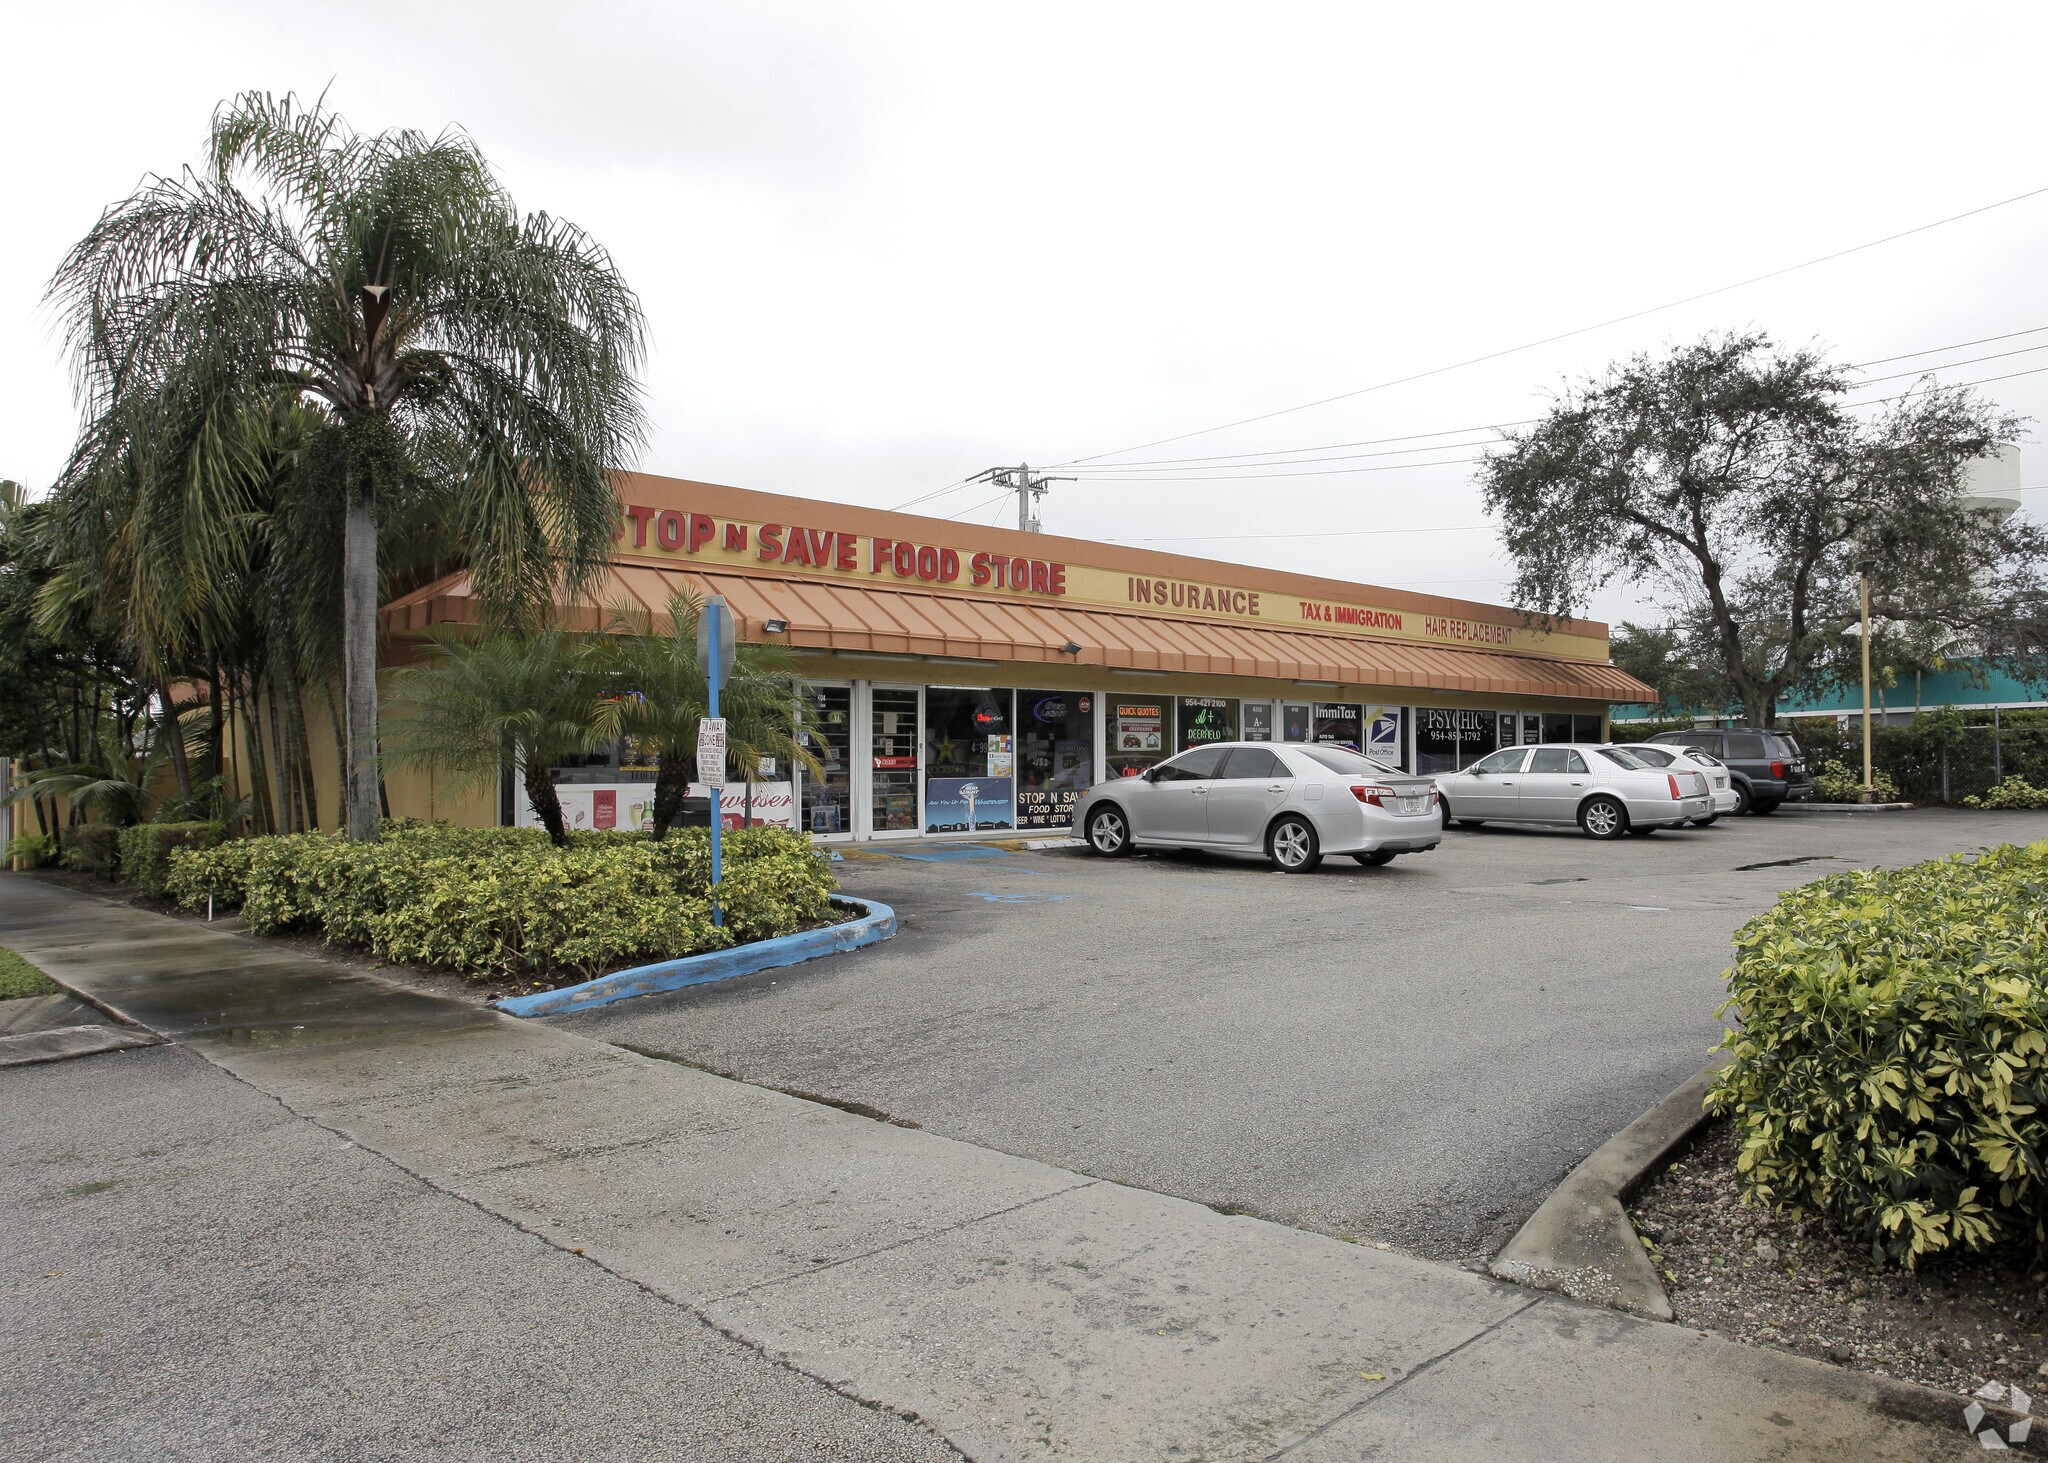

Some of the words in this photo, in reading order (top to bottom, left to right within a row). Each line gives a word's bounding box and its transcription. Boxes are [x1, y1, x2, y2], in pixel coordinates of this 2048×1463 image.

[723, 523, 748, 552] N
[756, 523, 858, 570] SAVE
[870, 537, 960, 582] FOOD
[968, 552, 1066, 595] STORE
[1128, 576, 1261, 616] INSURANCE
[1299, 601, 1322, 621] TAX
[1324, 604, 1332, 622] &
[1334, 606, 1402, 630] IMMIGRATION
[1425, 616, 1448, 638] HAIR
[1450, 619, 1513, 645] REPLACEMENT
[1120, 707, 1137, 716] QUICK
[1137, 707, 1160, 717] QUOTES
[1315, 705, 1356, 719] ImmiTax
[1428, 710, 1483, 729] PSYCHIC
[1187, 729, 1221, 740] DEERFIELD
[1369, 748, 1379, 756] Post
[1379, 748, 1394, 756] Office
[1018, 792, 1046, 804] STOP
[1050, 792, 1058, 803] N
[1063, 791, 1078, 803] SAV
[1028, 805, 1050, 813] FOOD
[1054, 804, 1074, 813] STOR
[1033, 815, 1045, 824] WINE
[1050, 814, 1066, 823] LOTTO
